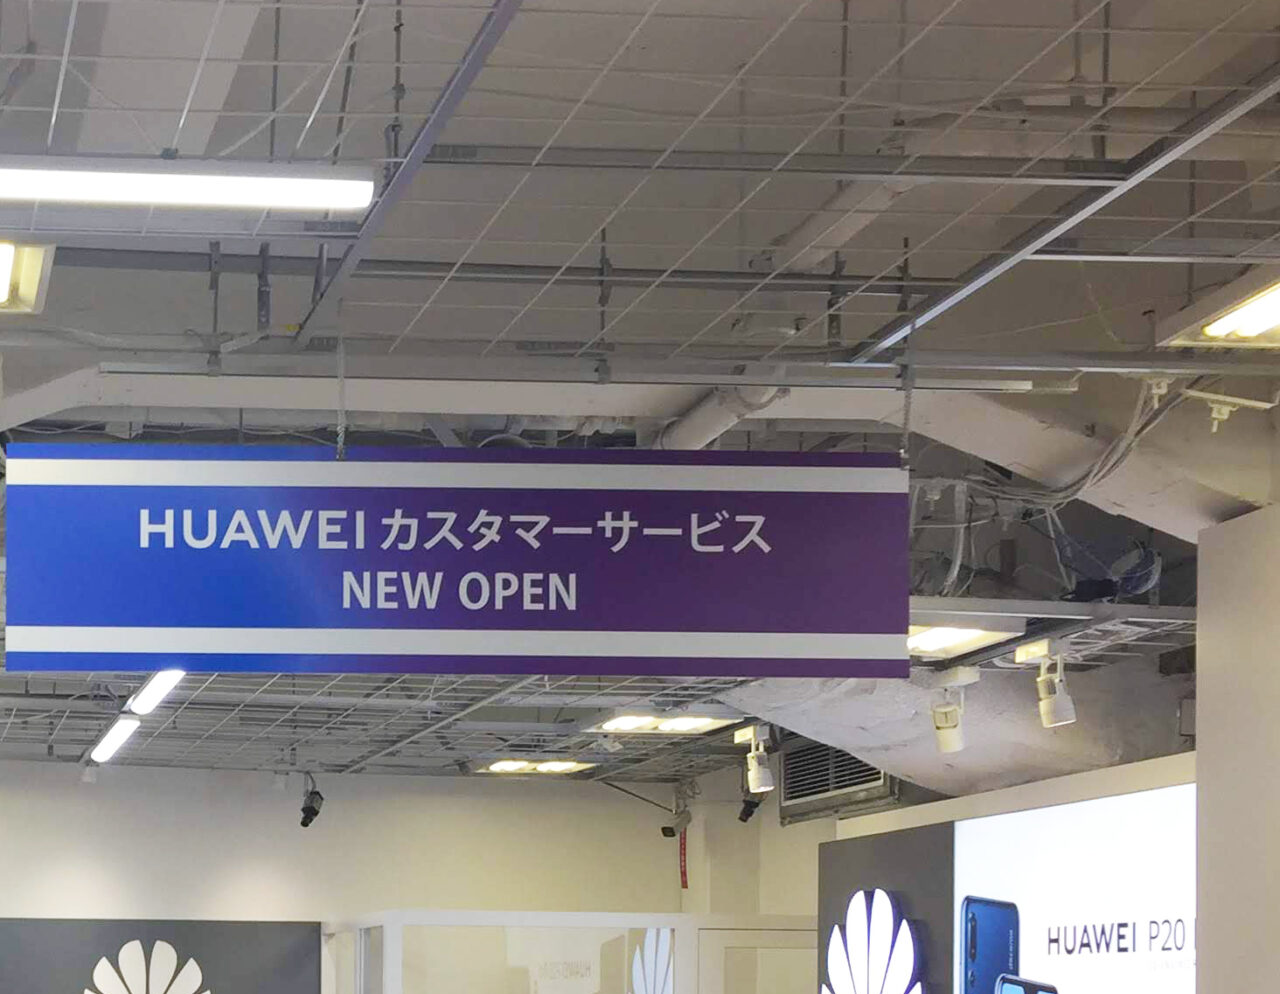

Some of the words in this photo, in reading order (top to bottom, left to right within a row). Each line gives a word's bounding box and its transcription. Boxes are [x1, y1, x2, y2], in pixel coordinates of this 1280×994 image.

[139, 509, 365, 550] HUAWEI
[380, 511, 773, 556] カスタマーサービス
[343, 572, 442, 610] NEW
[459, 574, 578, 611] OPEN
[1048, 921, 1137, 956] HUAWEI
[1148, 918, 1186, 952] P20
